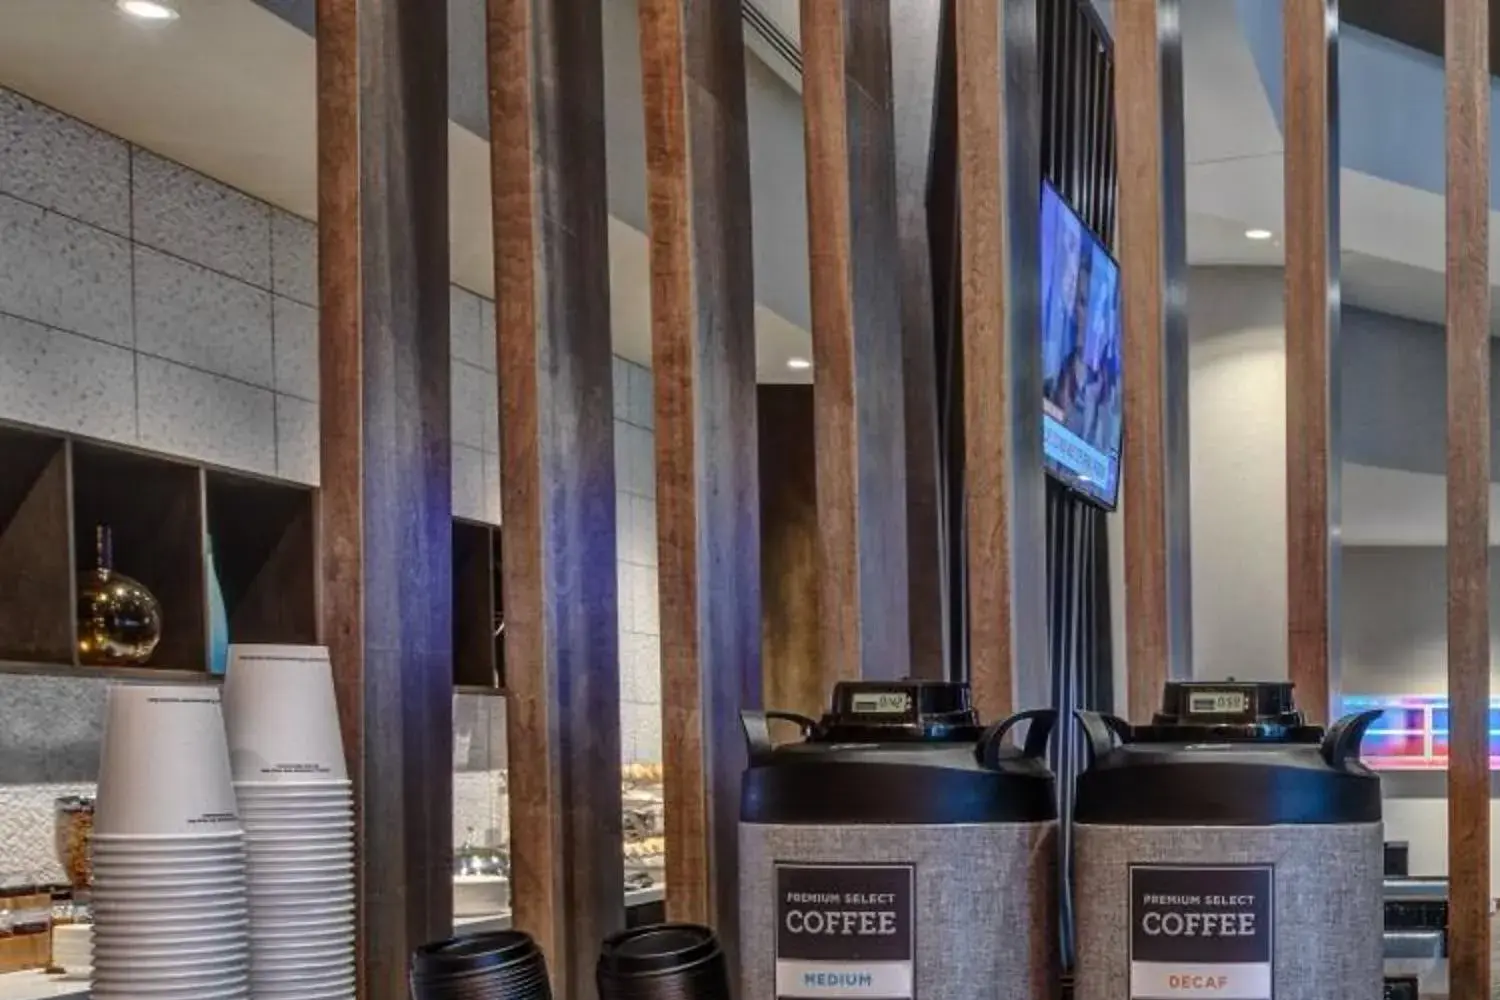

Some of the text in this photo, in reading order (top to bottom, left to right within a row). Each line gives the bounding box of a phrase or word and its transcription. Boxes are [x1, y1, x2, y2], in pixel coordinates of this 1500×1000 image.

[786, 891, 897, 904] PREMIUM SELECT
[1143, 894, 1256, 906] PREMIUM SELECT
[786, 909, 897, 935] COFFEE
[1142, 911, 1256, 936] COFFEE
[804, 973, 872, 987] MEDIUM
[1169, 974, 1228, 989] DECAF
